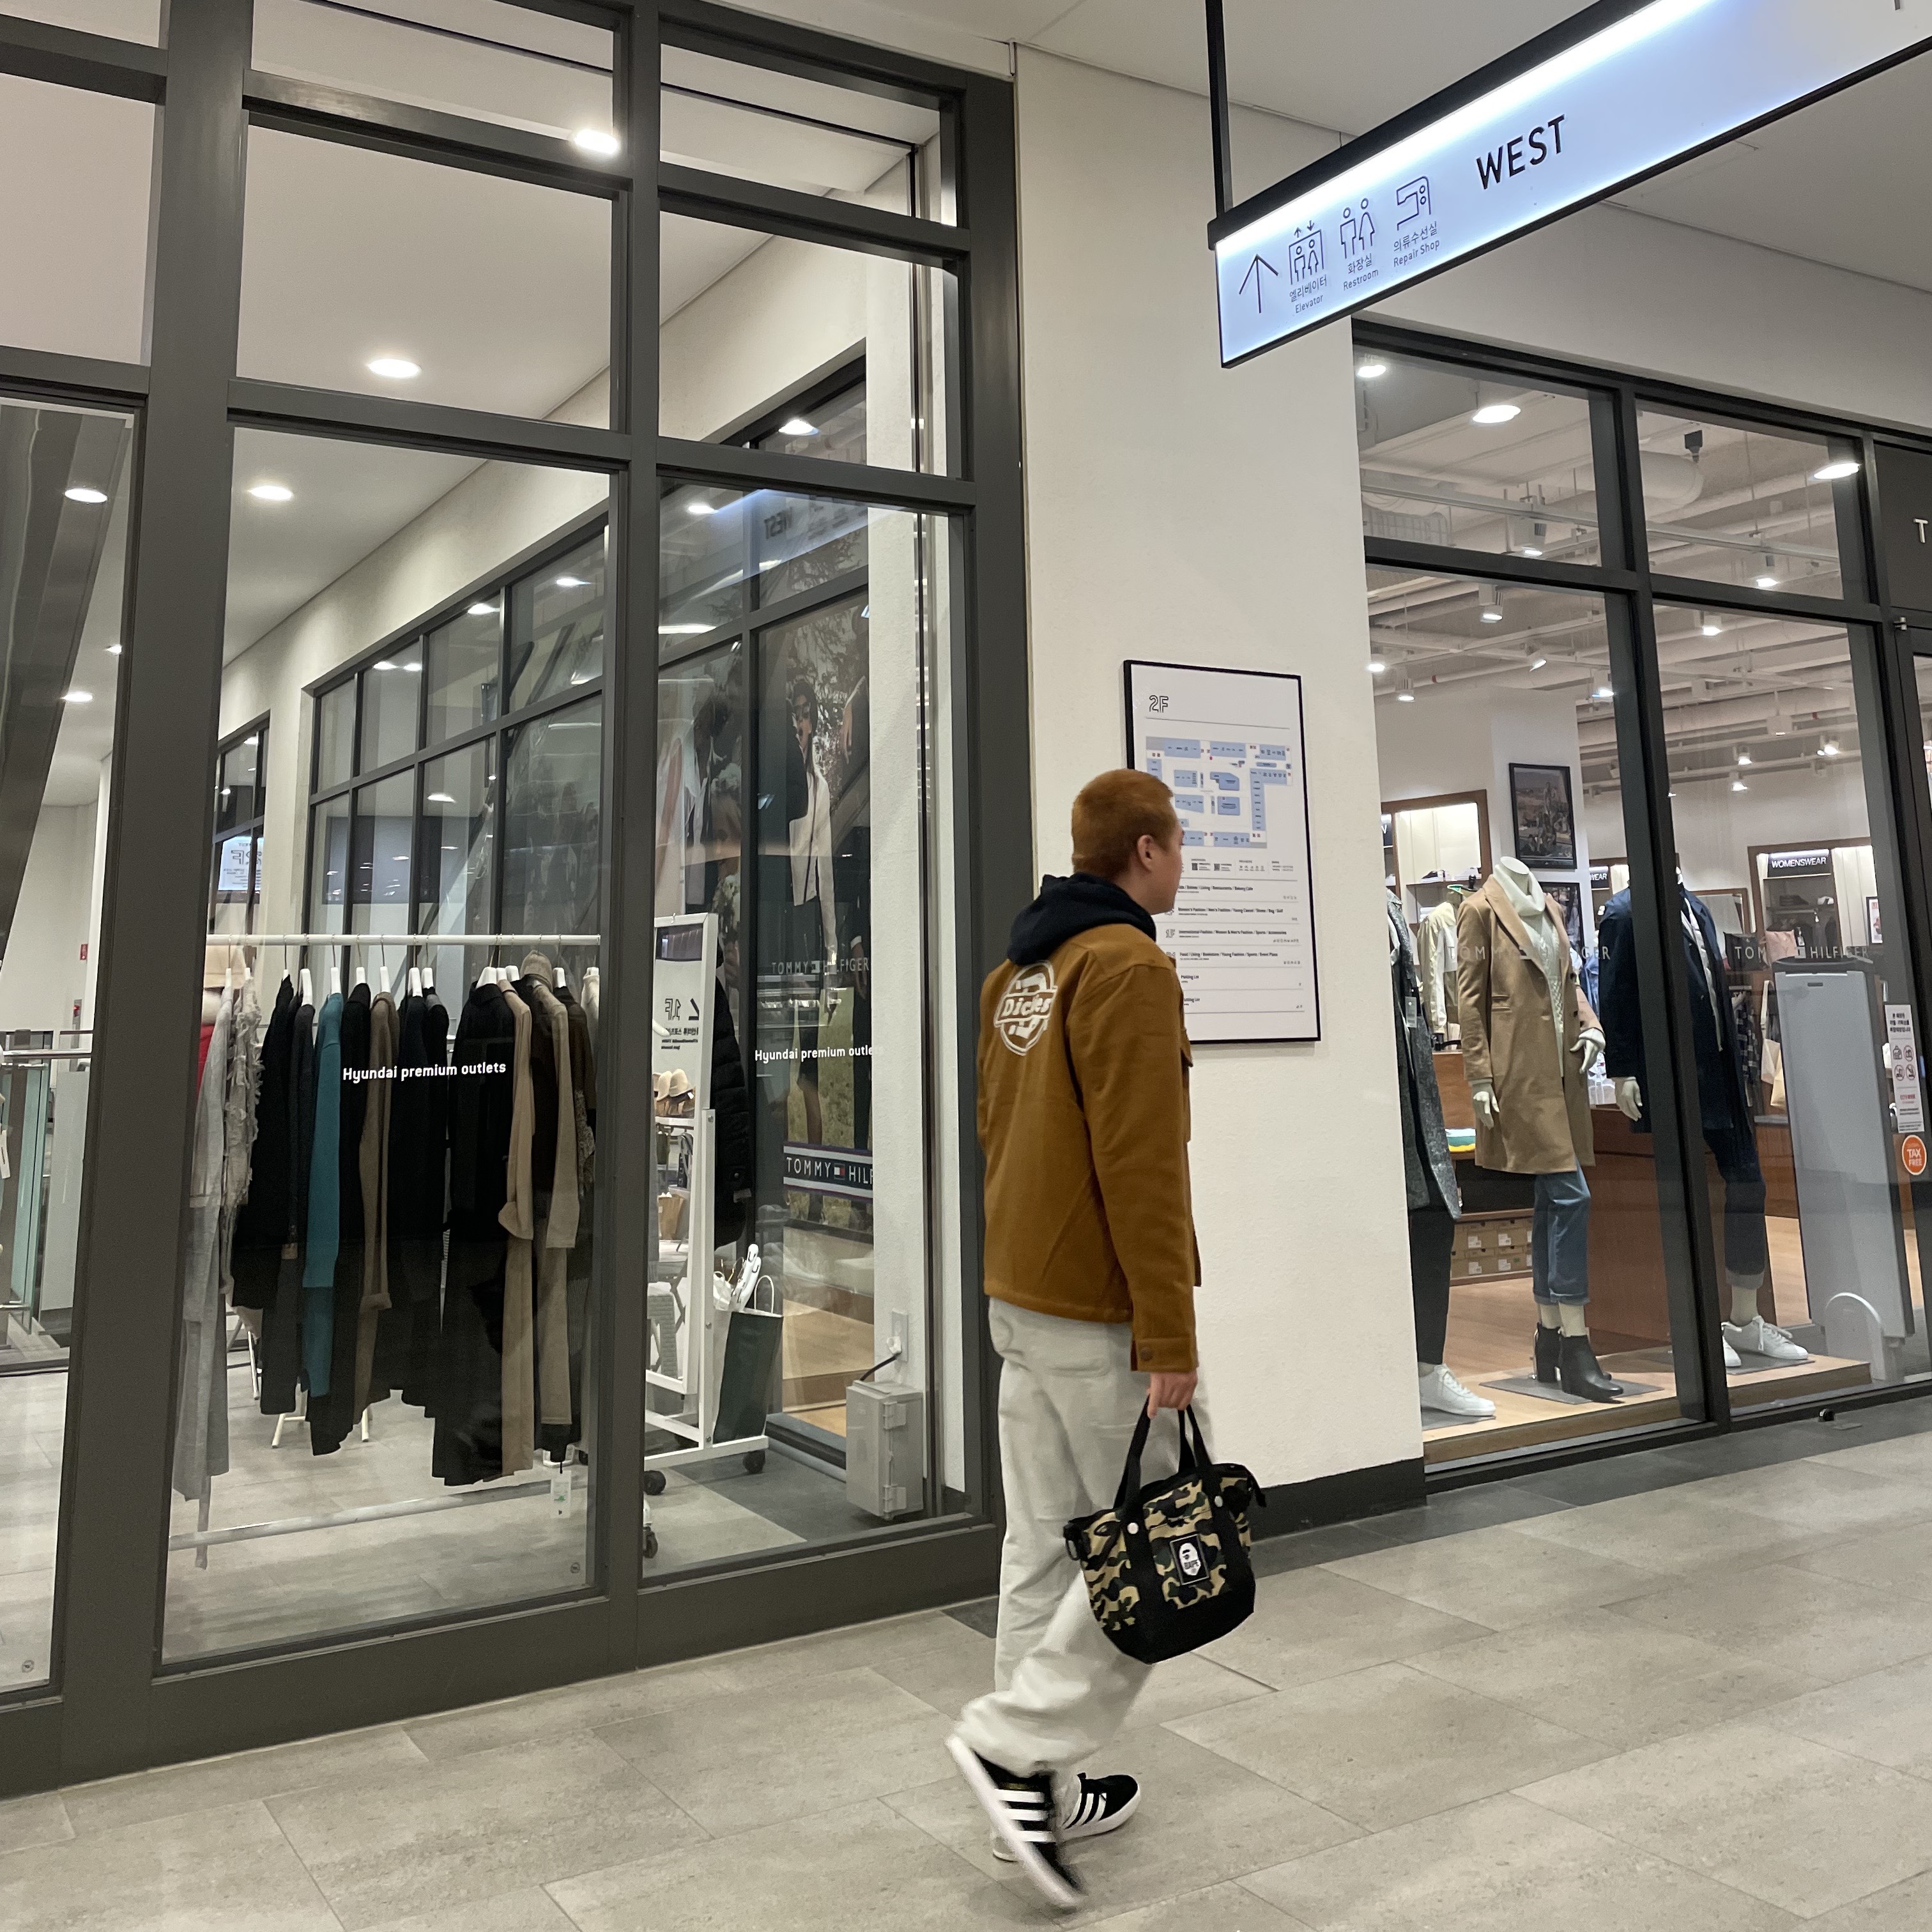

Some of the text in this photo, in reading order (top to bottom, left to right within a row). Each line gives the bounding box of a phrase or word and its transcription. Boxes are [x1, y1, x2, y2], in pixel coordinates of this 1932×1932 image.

[1476, 114, 1565, 190] WEST
[1393, 221, 1438, 252] 의류수선실
[1347, 253, 1372, 274] 화장실
[1393, 240, 1440, 267] Repair Shop
[1289, 274, 1328, 302] 엘리베이터
[1344, 269, 1379, 291] Restroom
[1295, 295, 1324, 313] Elevator
[1149, 694, 1169, 713] 2F
[1771, 857, 1827, 868] WOMENSWEAR
[771, 957, 870, 975] TOMMY HFIGER
[755, 1045, 873, 1064] Hyundai premium outle
[342, 1062, 506, 1084] Hyundai premium outlets
[1906, 1148, 1920, 1160] TAX
[786, 1157, 831, 1178] TOMMY
